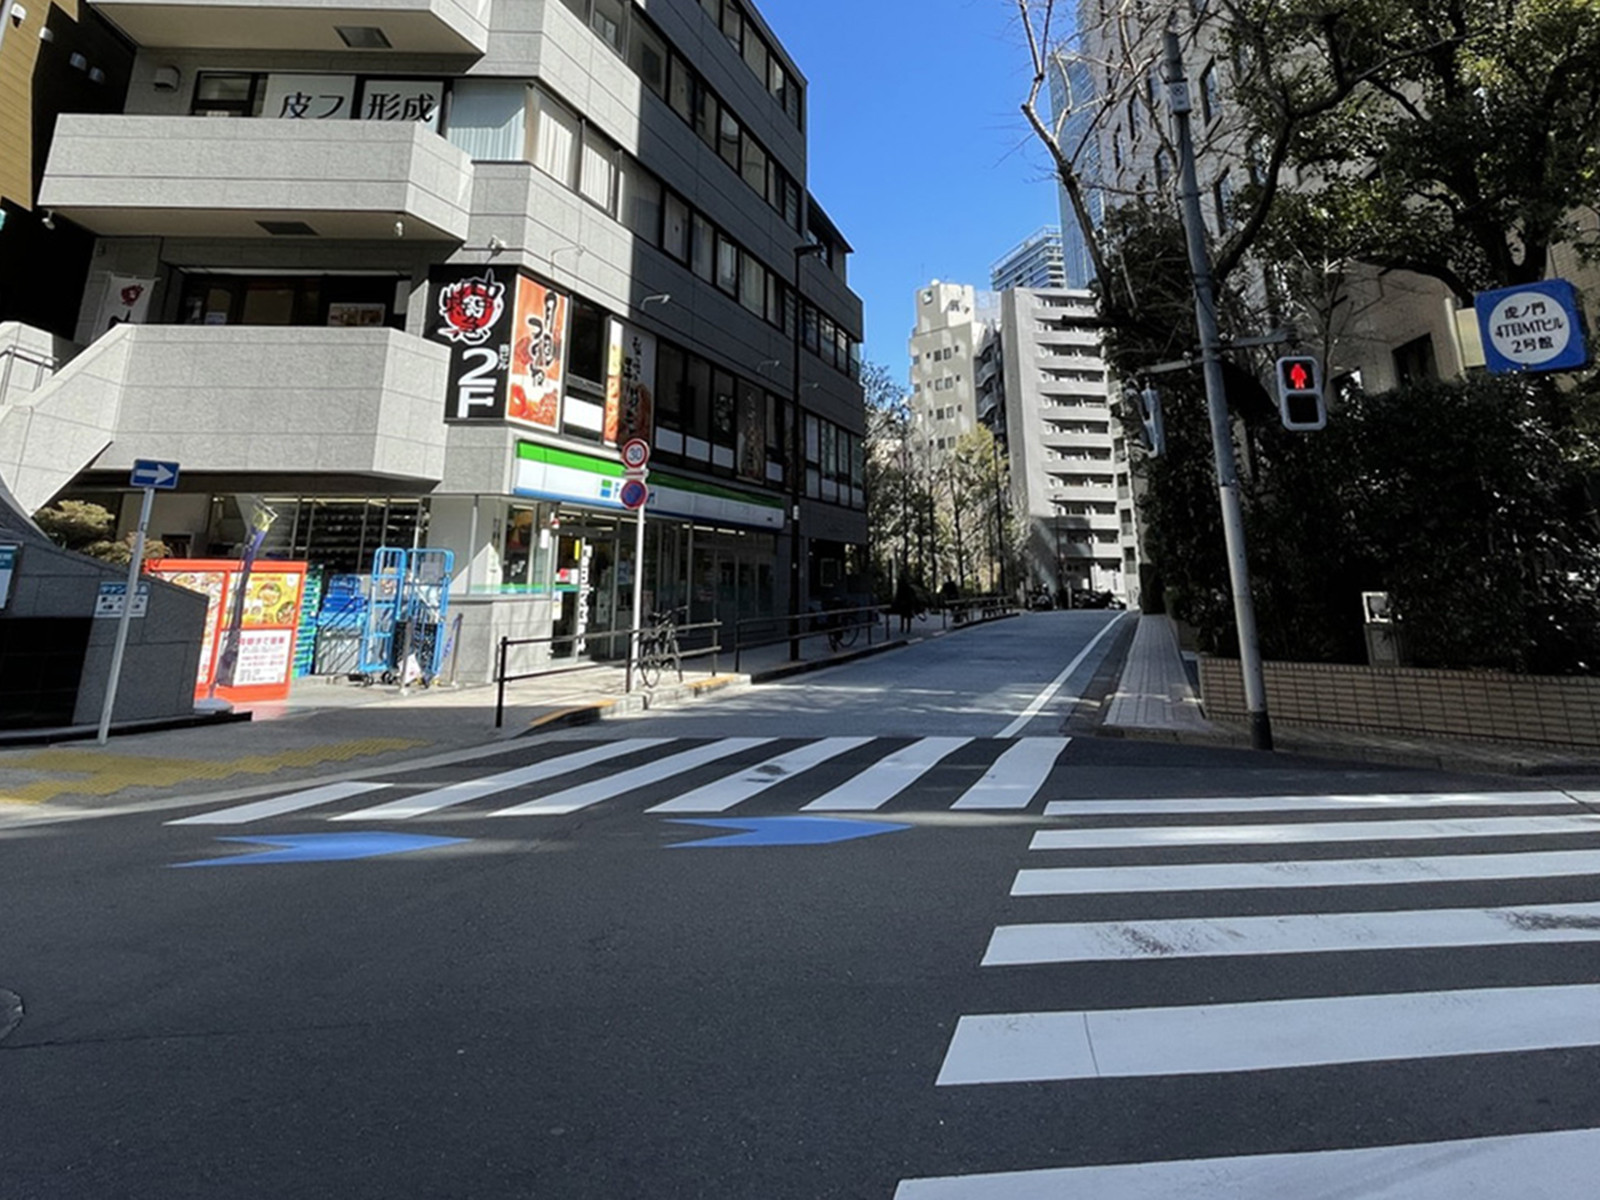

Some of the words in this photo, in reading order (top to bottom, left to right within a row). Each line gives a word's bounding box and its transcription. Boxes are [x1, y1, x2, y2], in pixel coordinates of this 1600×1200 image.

[368, 93, 435, 122] 形成
[1504, 301, 1547, 320] 虎ノ門
[1512, 335, 1555, 353] 2号館
[457, 347, 499, 418] 2F
[629, 447, 642, 461] 30
